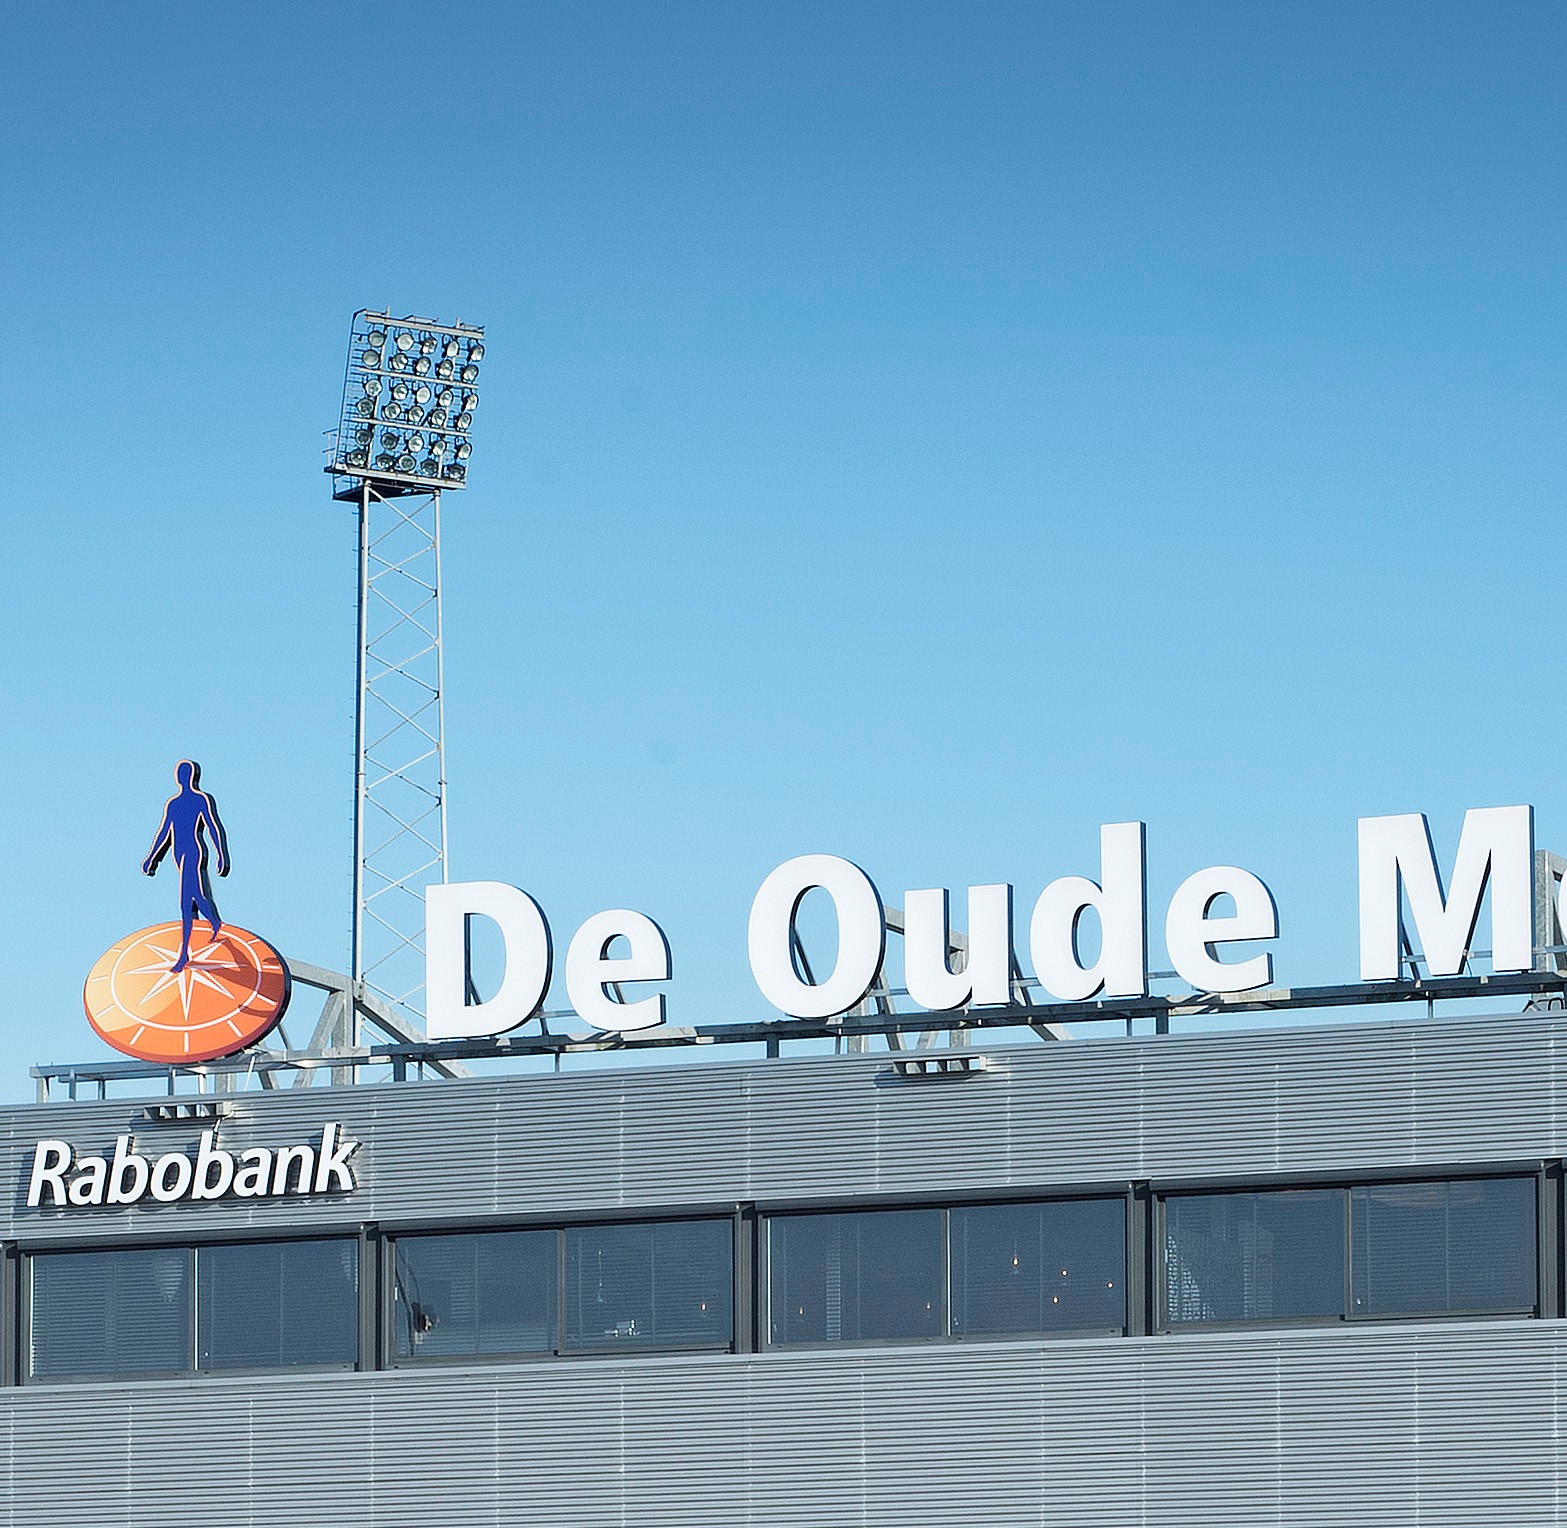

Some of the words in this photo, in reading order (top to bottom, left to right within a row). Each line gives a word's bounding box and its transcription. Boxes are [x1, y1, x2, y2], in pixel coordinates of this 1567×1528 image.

[425, 880, 673, 1041] De
[748, 820, 1280, 1019] Oude
[26, 1121, 364, 1207] Rabobank
